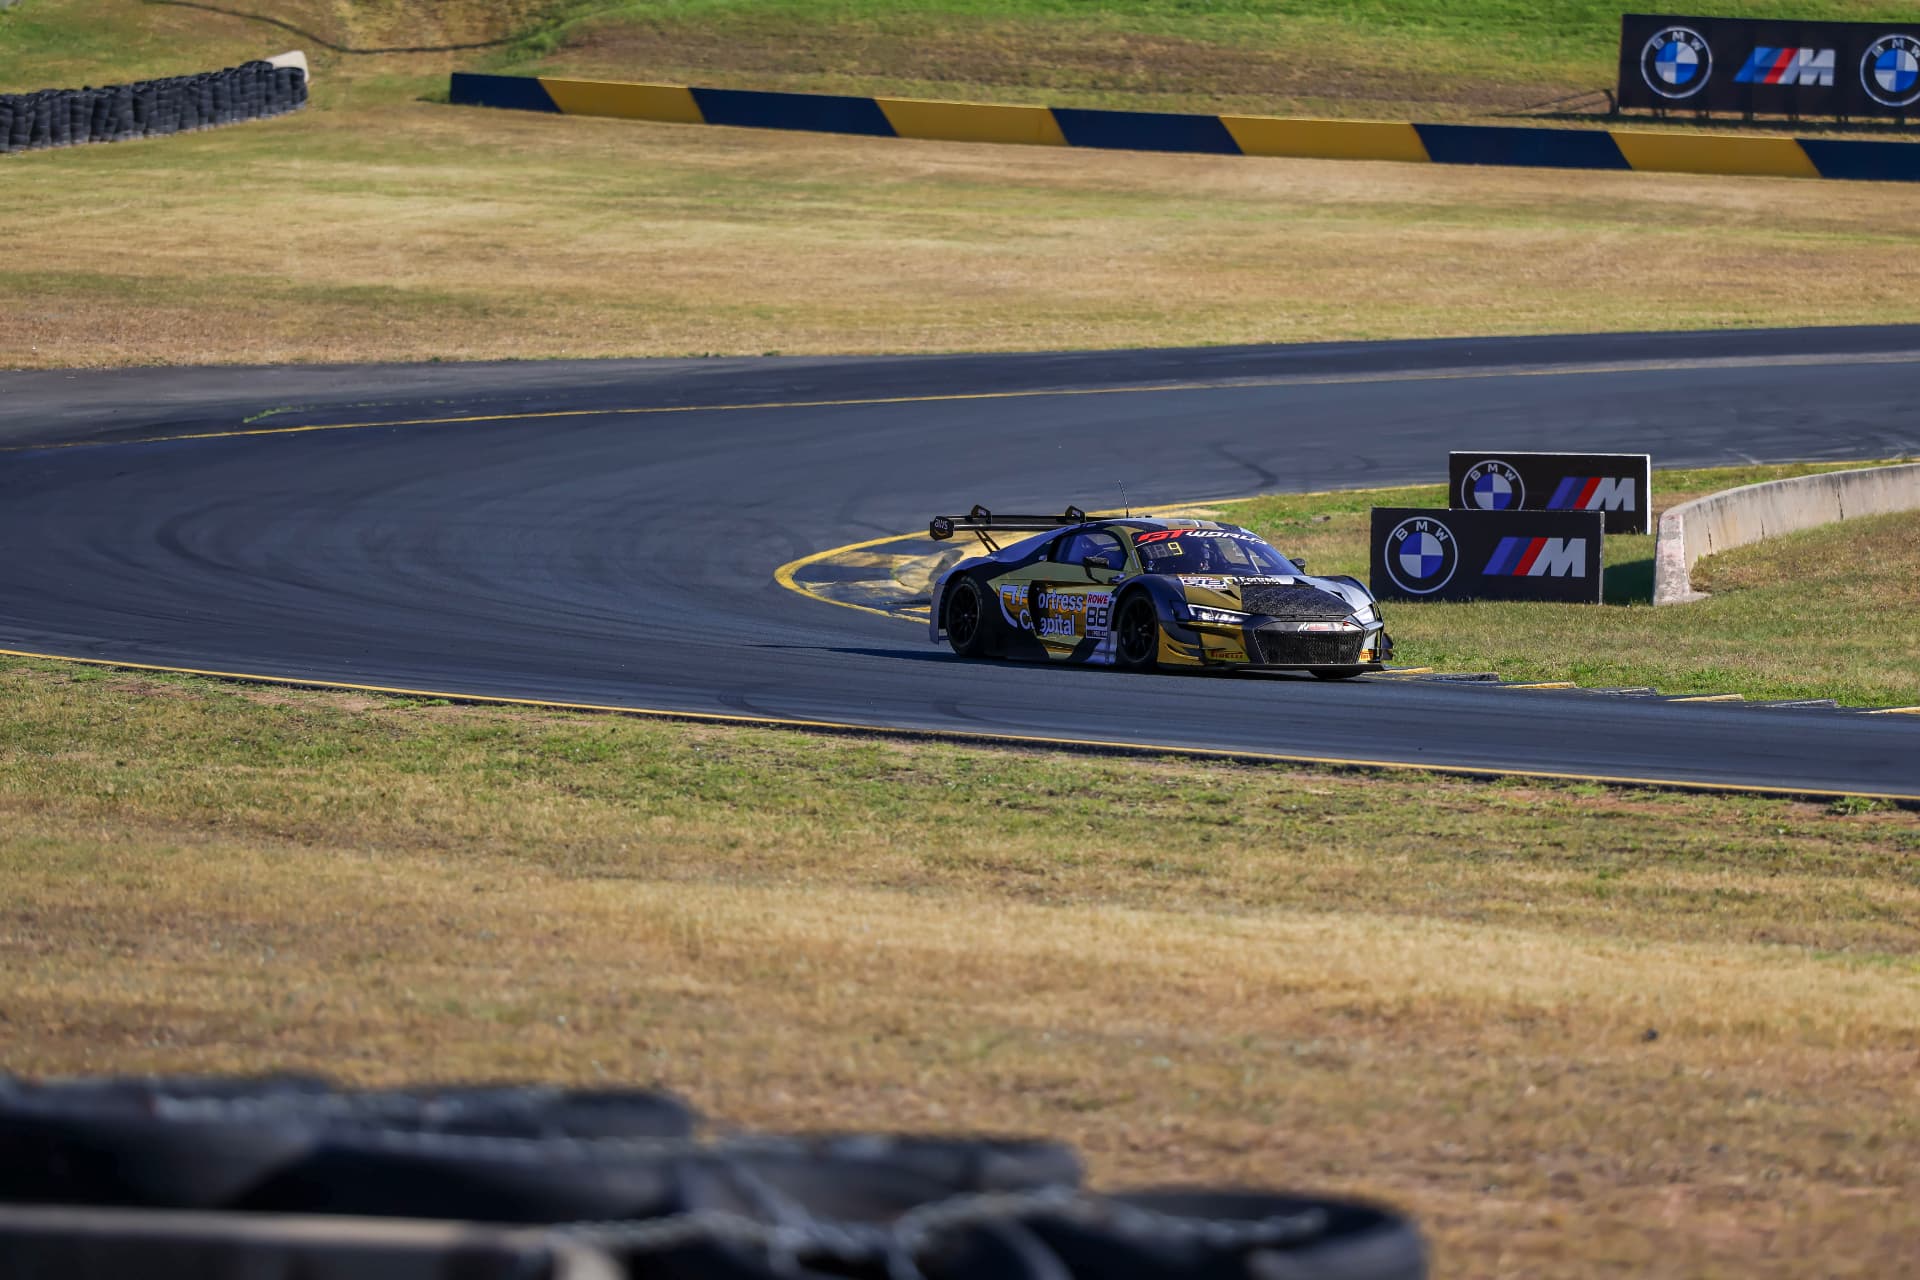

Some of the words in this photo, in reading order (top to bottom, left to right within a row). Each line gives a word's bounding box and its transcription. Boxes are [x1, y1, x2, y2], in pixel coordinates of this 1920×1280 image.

[1651, 30, 1705, 51] BMW
[1470, 463, 1517, 482] BMW
[934, 518, 949, 530] aws
[1395, 520, 1449, 542] BMW
[1019, 585, 1084, 611] Fortress
[1087, 593, 1109, 605] ROWE
[1019, 608, 1075, 636] Capital
[1086, 607, 1108, 627] 88
